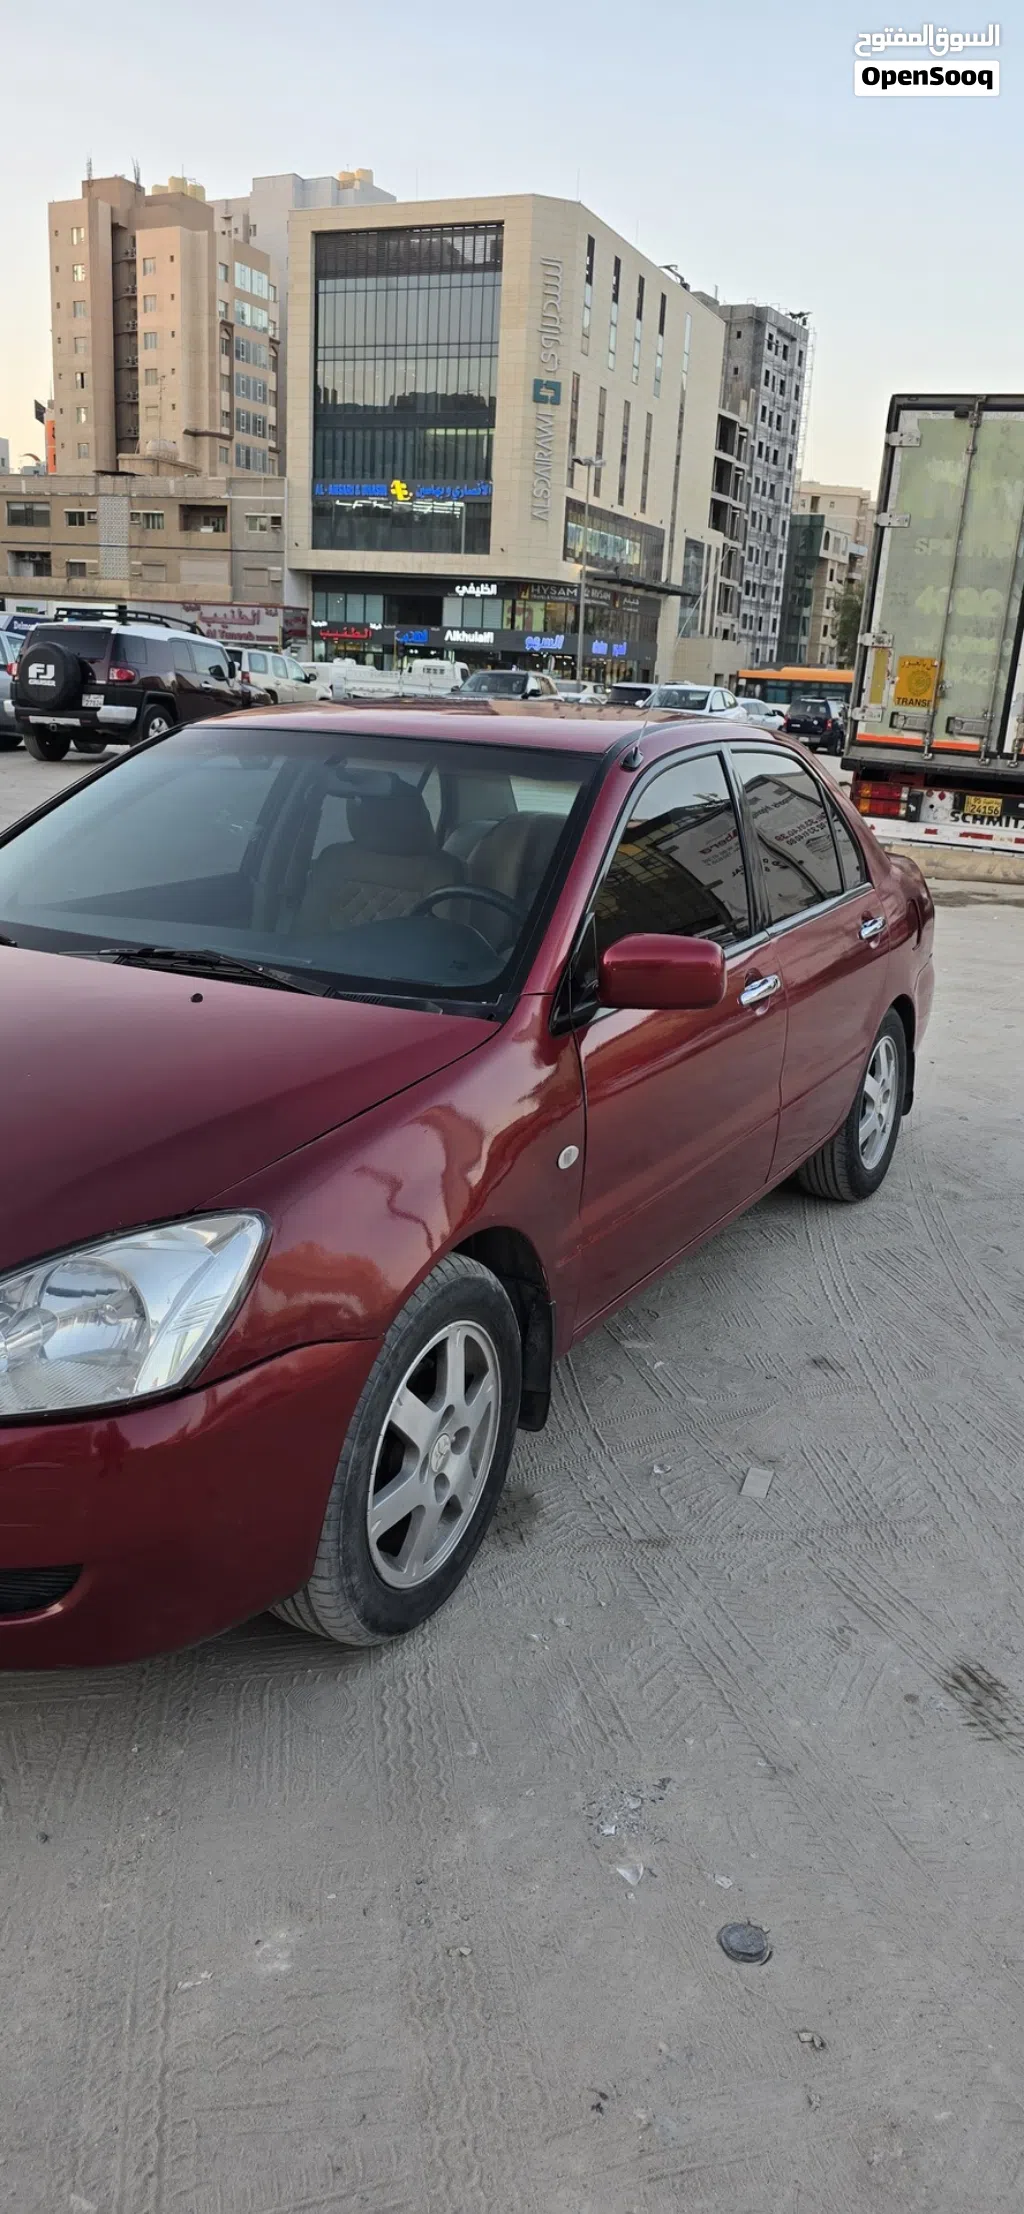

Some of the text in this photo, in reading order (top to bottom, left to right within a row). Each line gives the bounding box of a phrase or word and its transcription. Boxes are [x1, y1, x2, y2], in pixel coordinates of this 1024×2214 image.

[531, 585, 578, 597] HYSAM
[28, 663, 56, 679] FJ
[970, 805, 999, 815] 24156
